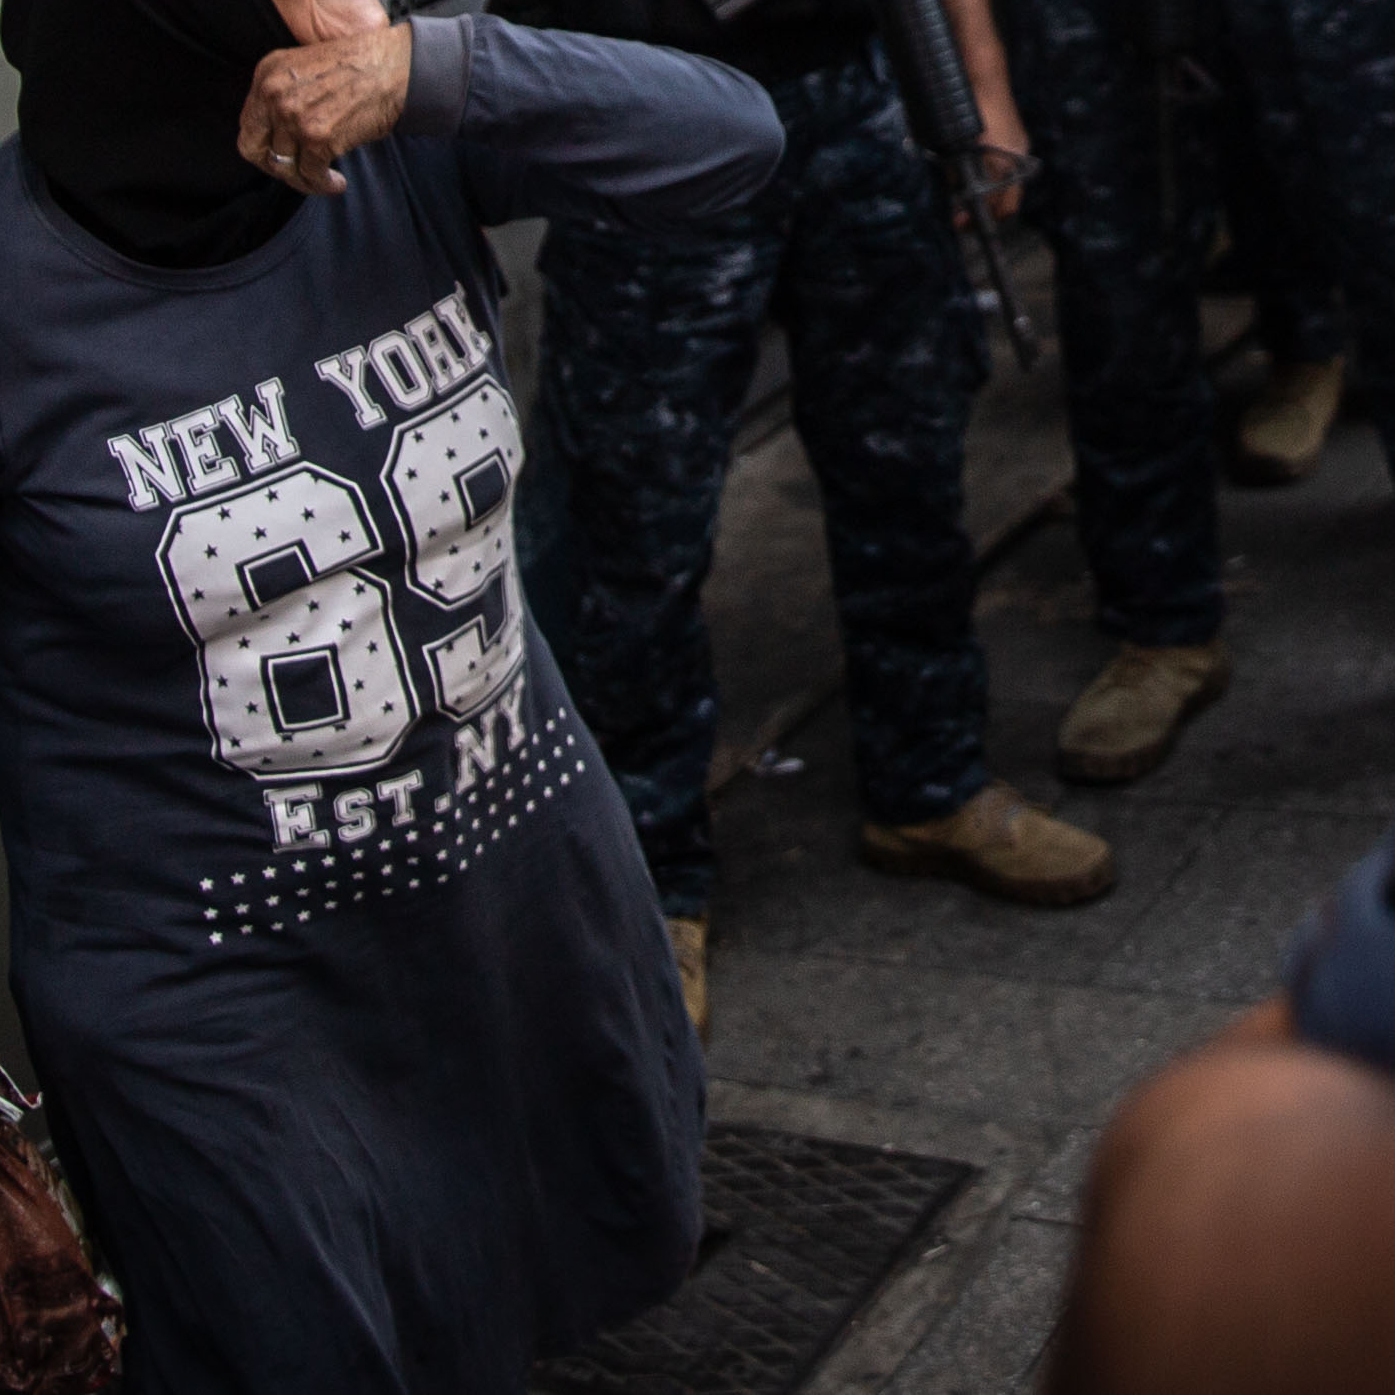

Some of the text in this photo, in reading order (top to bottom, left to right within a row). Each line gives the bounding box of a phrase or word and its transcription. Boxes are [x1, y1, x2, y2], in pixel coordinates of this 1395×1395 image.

[108, 281, 494, 513] NEW YORK
[156, 372, 527, 782] 69
